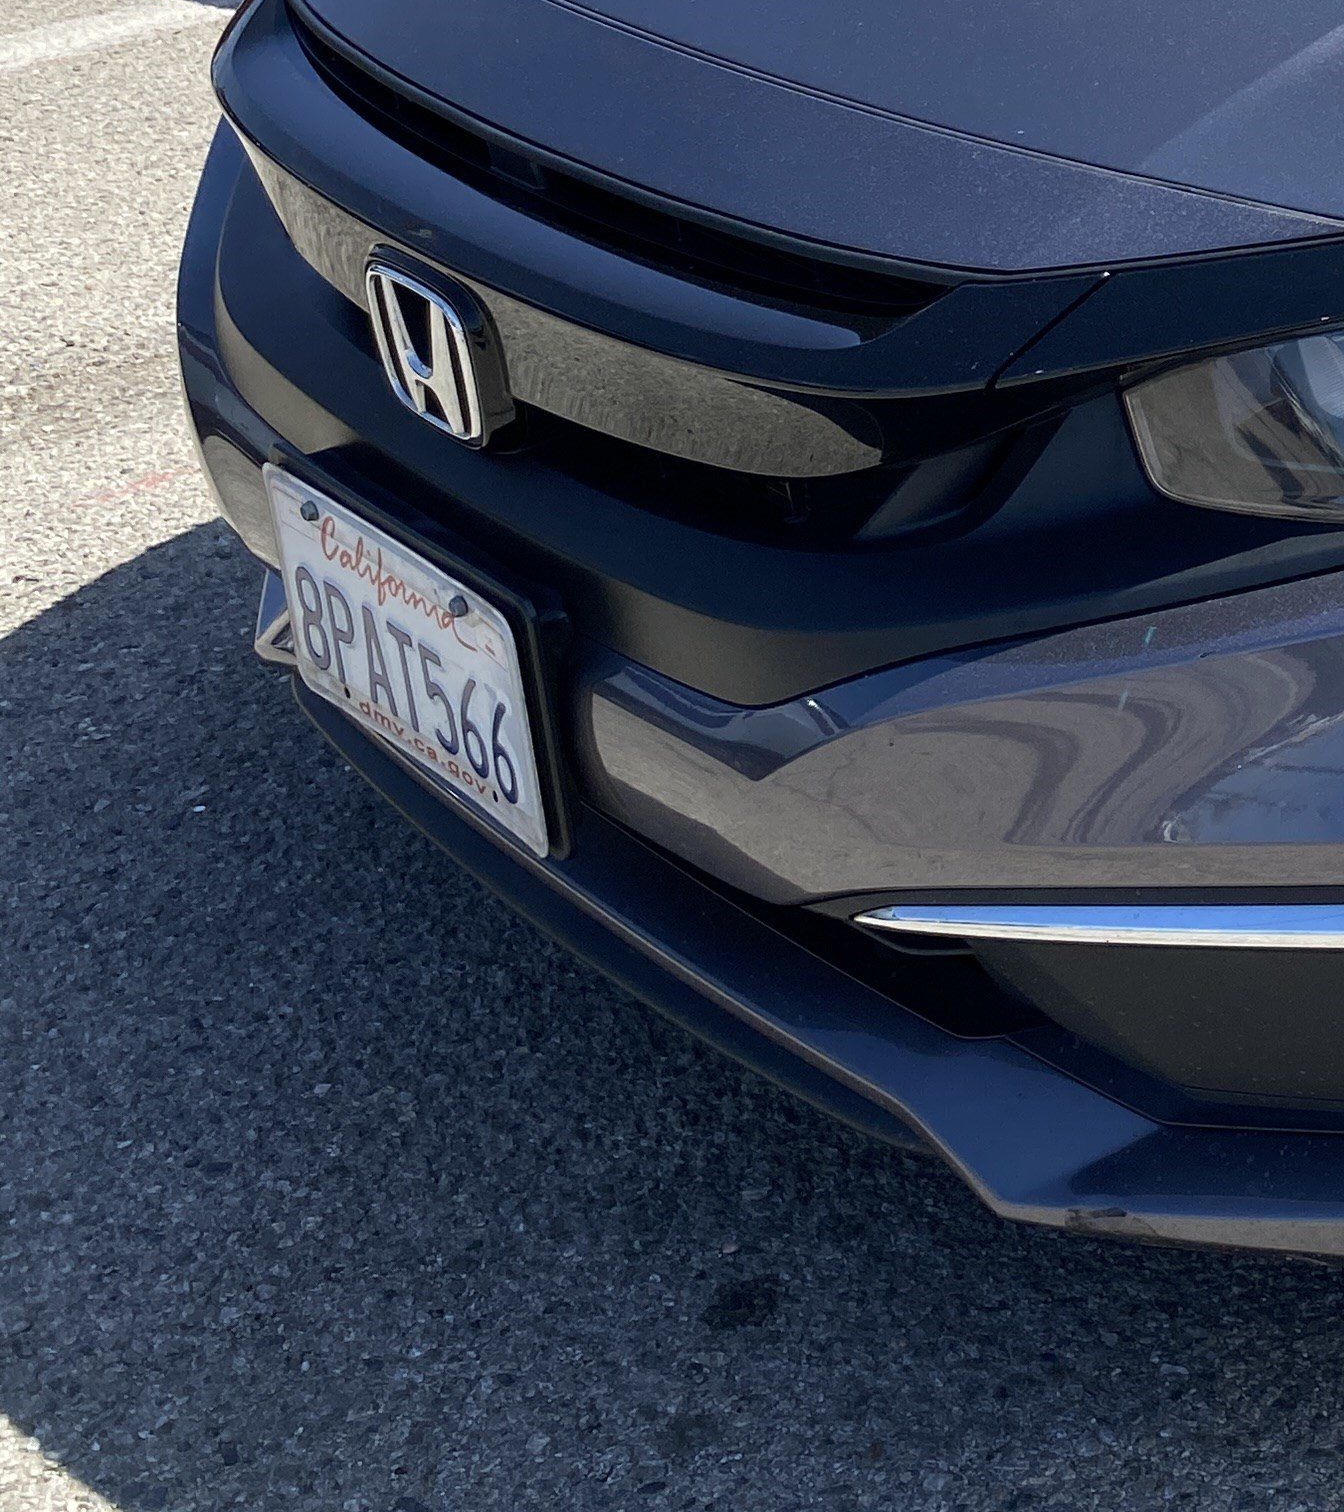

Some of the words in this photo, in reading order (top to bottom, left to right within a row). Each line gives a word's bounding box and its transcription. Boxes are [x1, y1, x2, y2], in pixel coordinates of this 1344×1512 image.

[319, 515, 478, 652] California
[295, 565, 520, 805] 8PAT566
[359, 700, 487, 796] dmv.ca.gov
